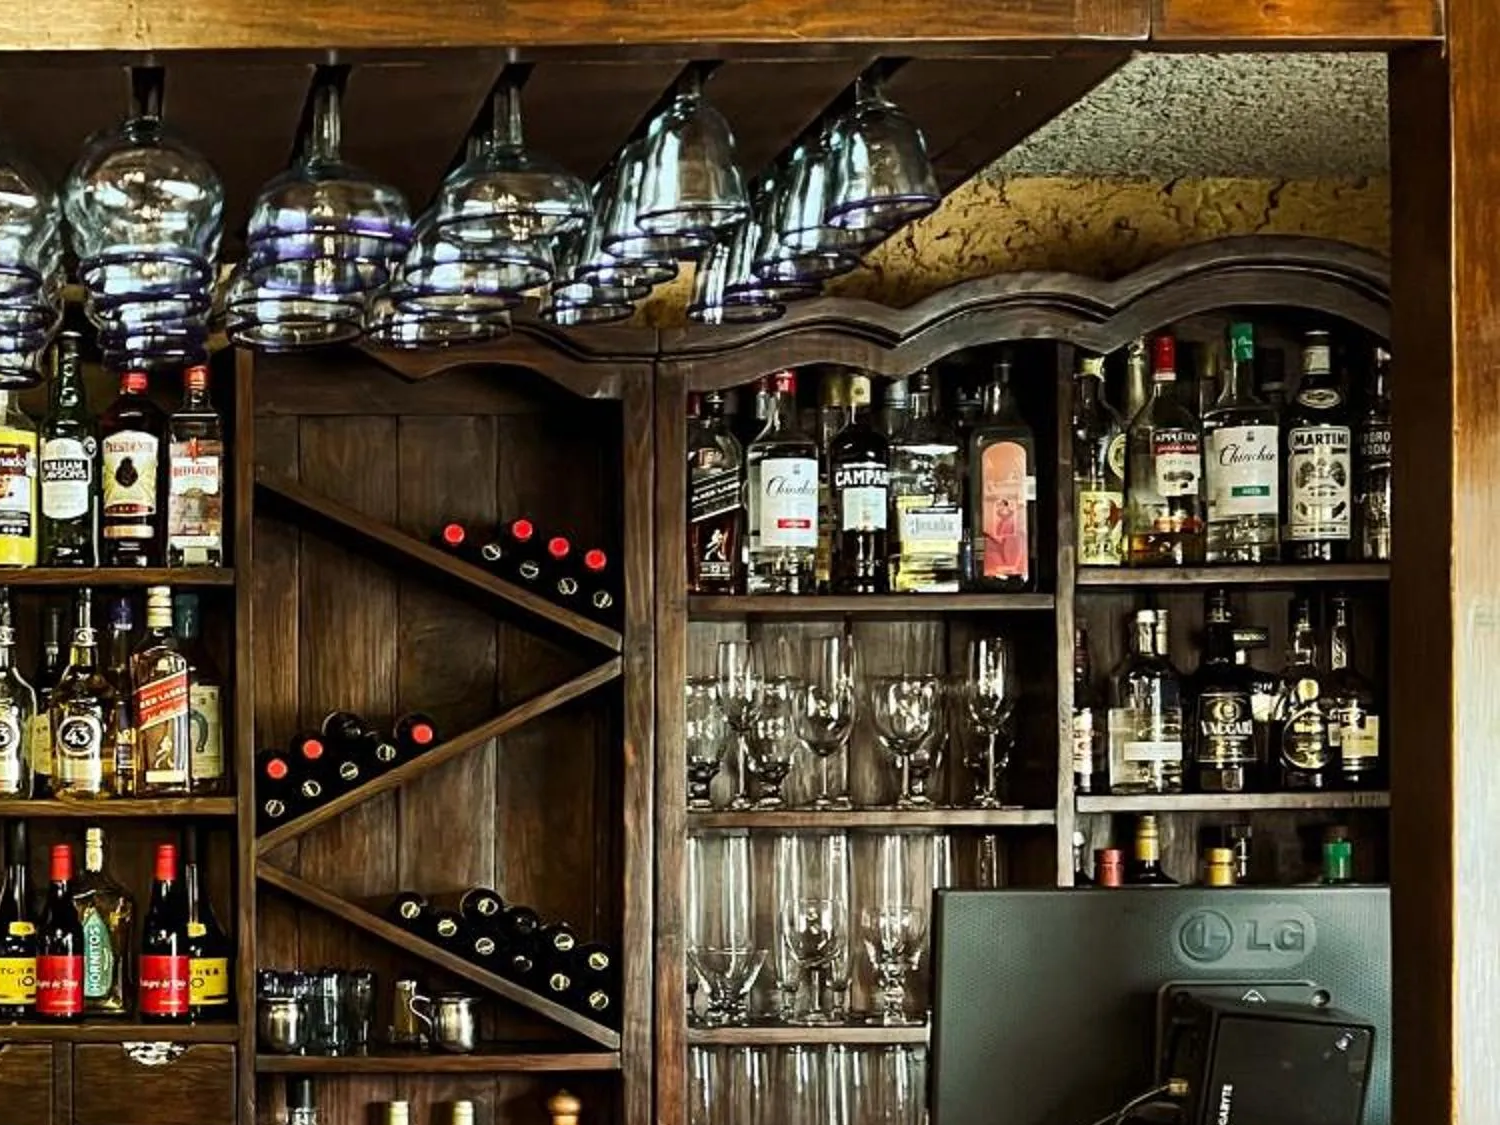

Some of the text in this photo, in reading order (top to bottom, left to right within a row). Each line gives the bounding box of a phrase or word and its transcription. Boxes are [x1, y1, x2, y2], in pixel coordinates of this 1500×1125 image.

[64, 724, 90, 746] 43
[1245, 918, 1306, 954] LG
[89, 925, 101, 991] HORNITOS
